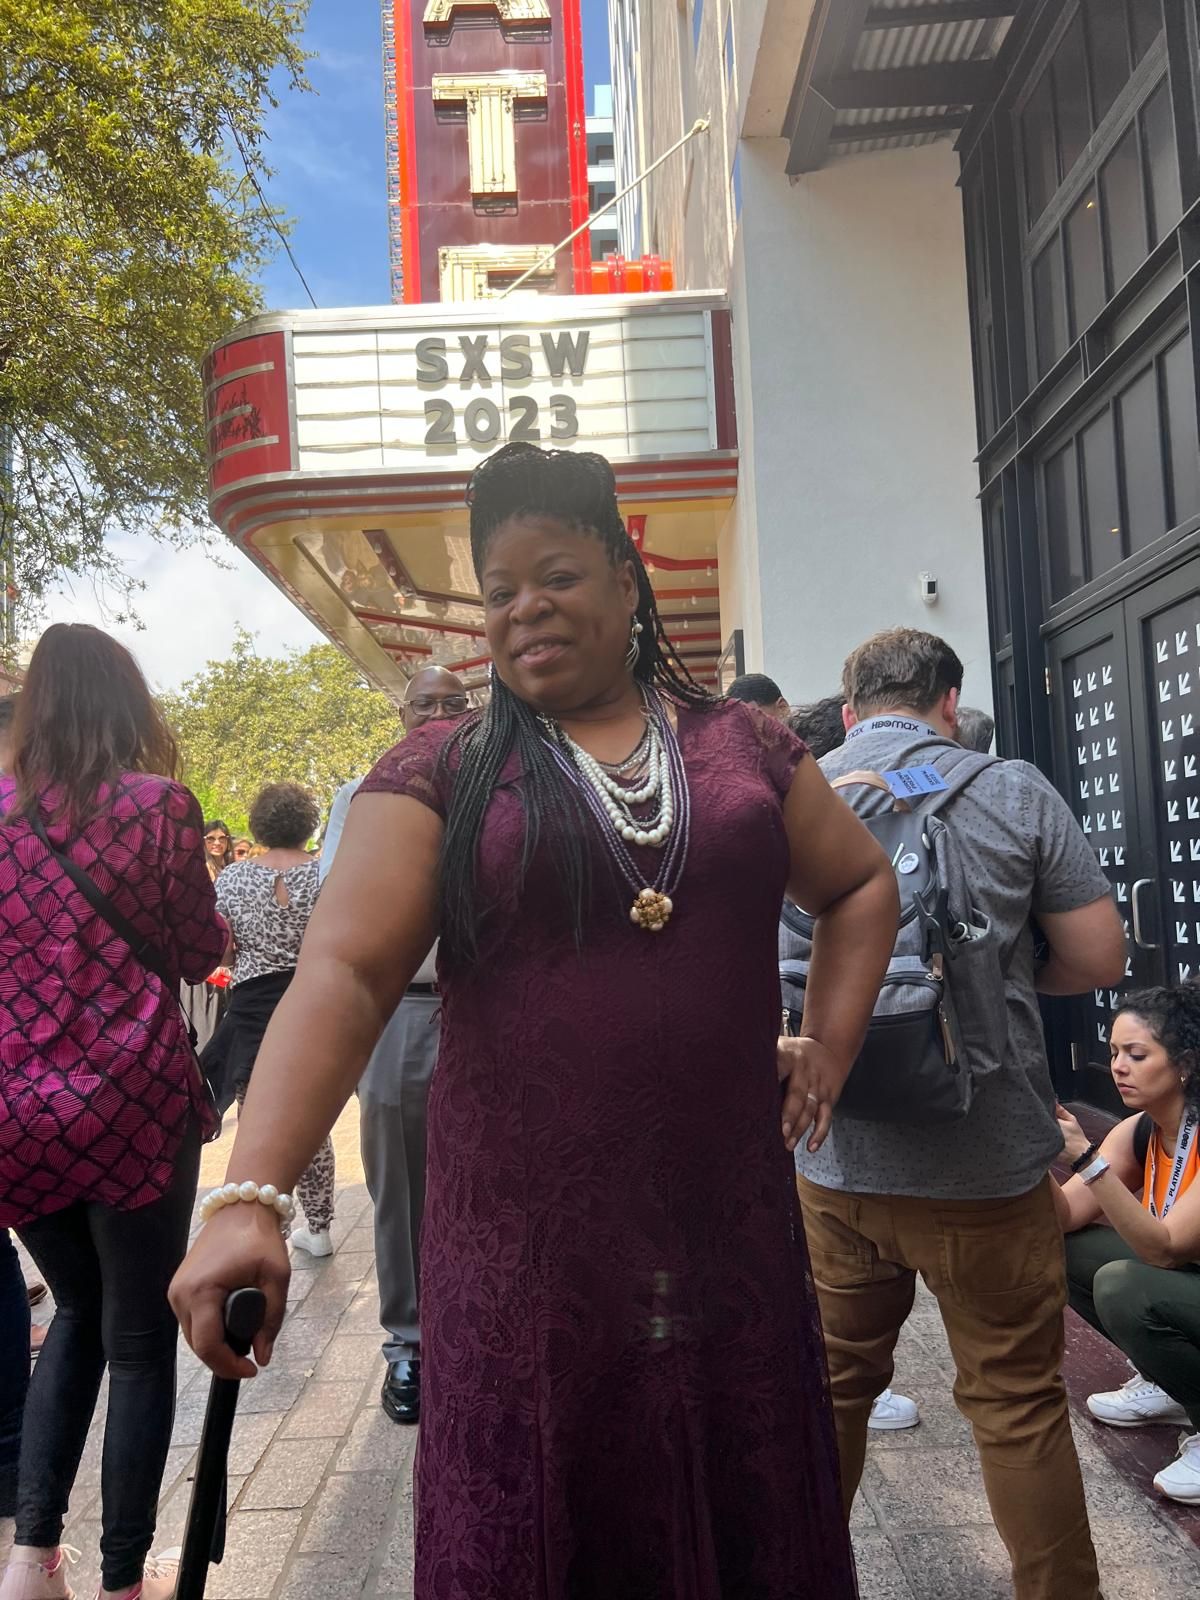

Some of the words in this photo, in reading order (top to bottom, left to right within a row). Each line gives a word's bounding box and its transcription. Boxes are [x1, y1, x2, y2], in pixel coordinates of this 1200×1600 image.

[415, 331, 590, 383] SXSW
[424, 394, 579, 444] 2023
[1168, 1155, 1184, 1197] PLATINUM
